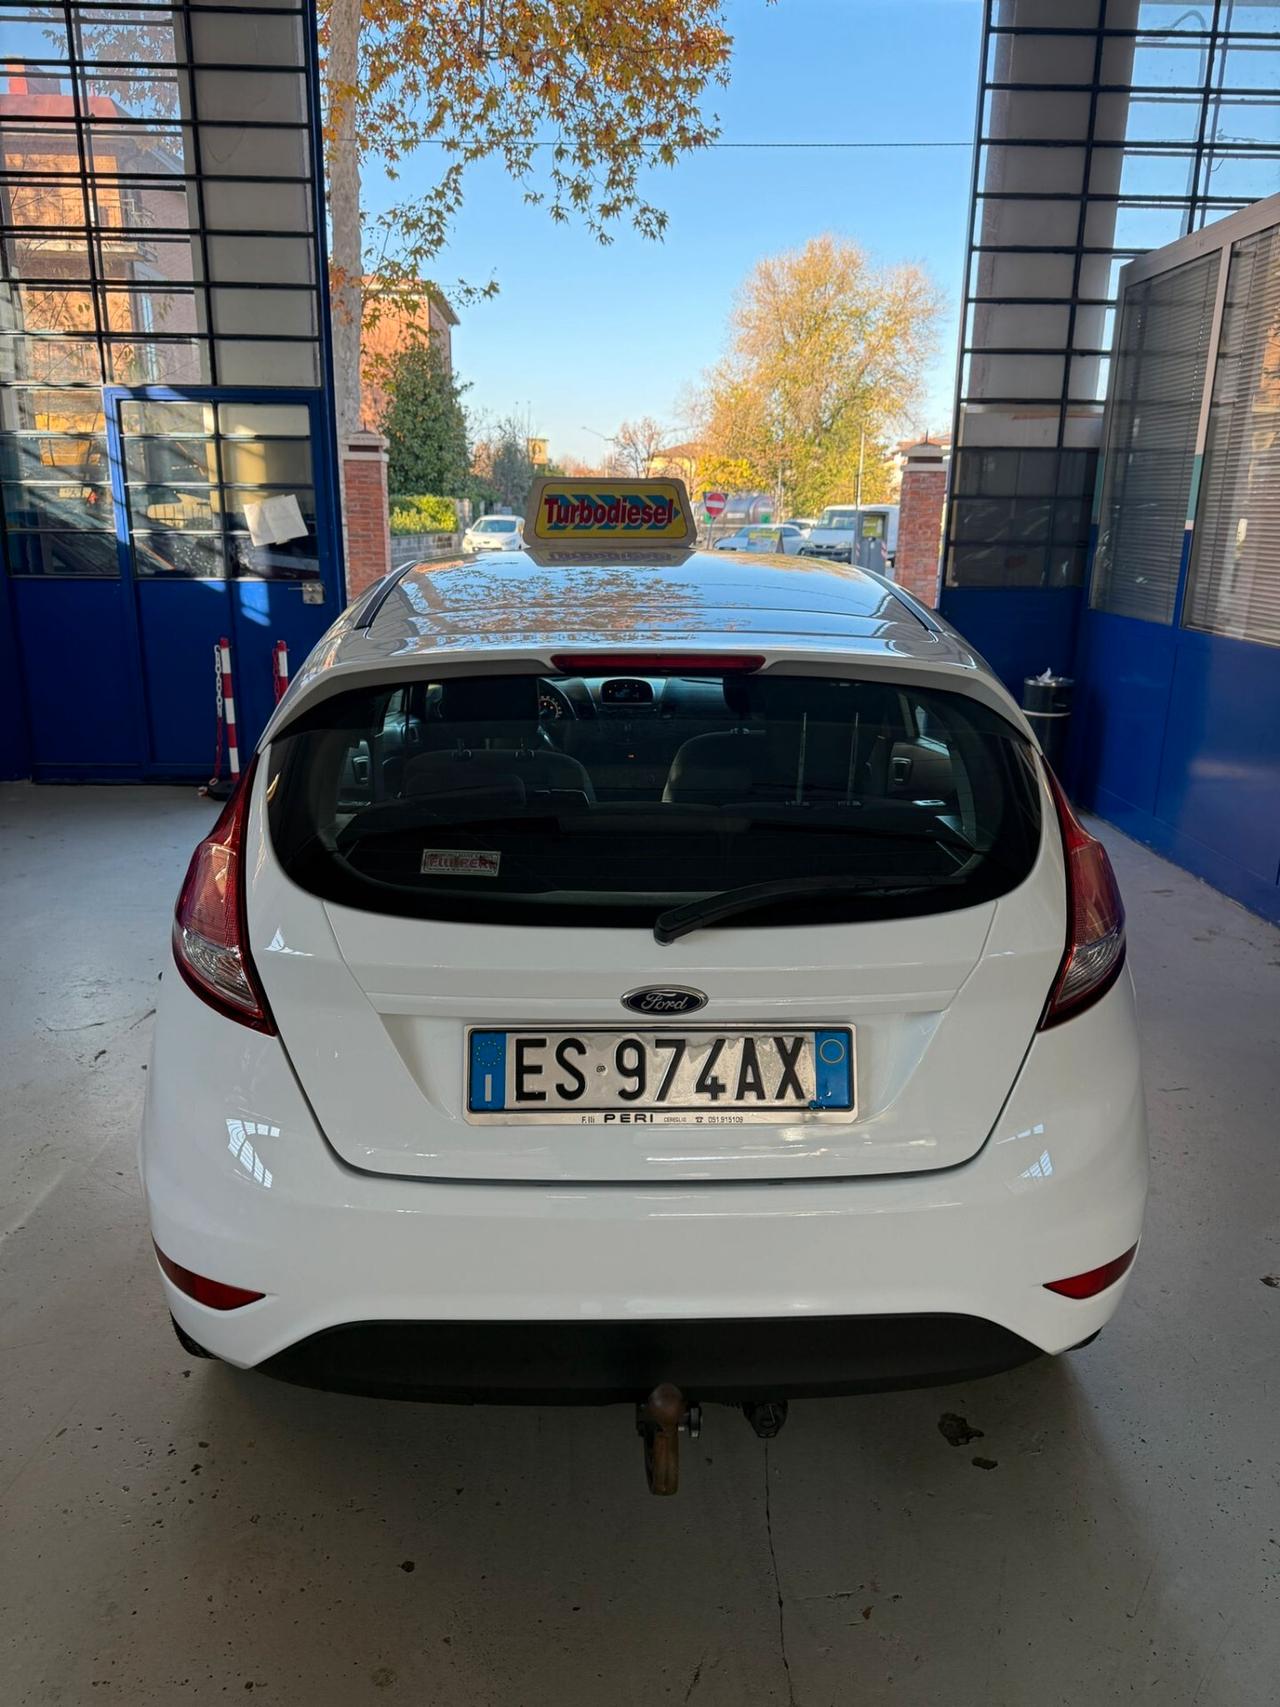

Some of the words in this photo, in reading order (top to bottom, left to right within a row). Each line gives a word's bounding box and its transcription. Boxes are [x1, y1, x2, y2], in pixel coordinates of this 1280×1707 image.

[544, 498, 674, 525] Turbodiesel
[641, 992, 689, 1010] Ford
[515, 1037, 587, 1102] ES
[615, 1036, 806, 1102] 974AX
[484, 1073, 493, 1102] I
[604, 1113, 653, 1124] PERI
